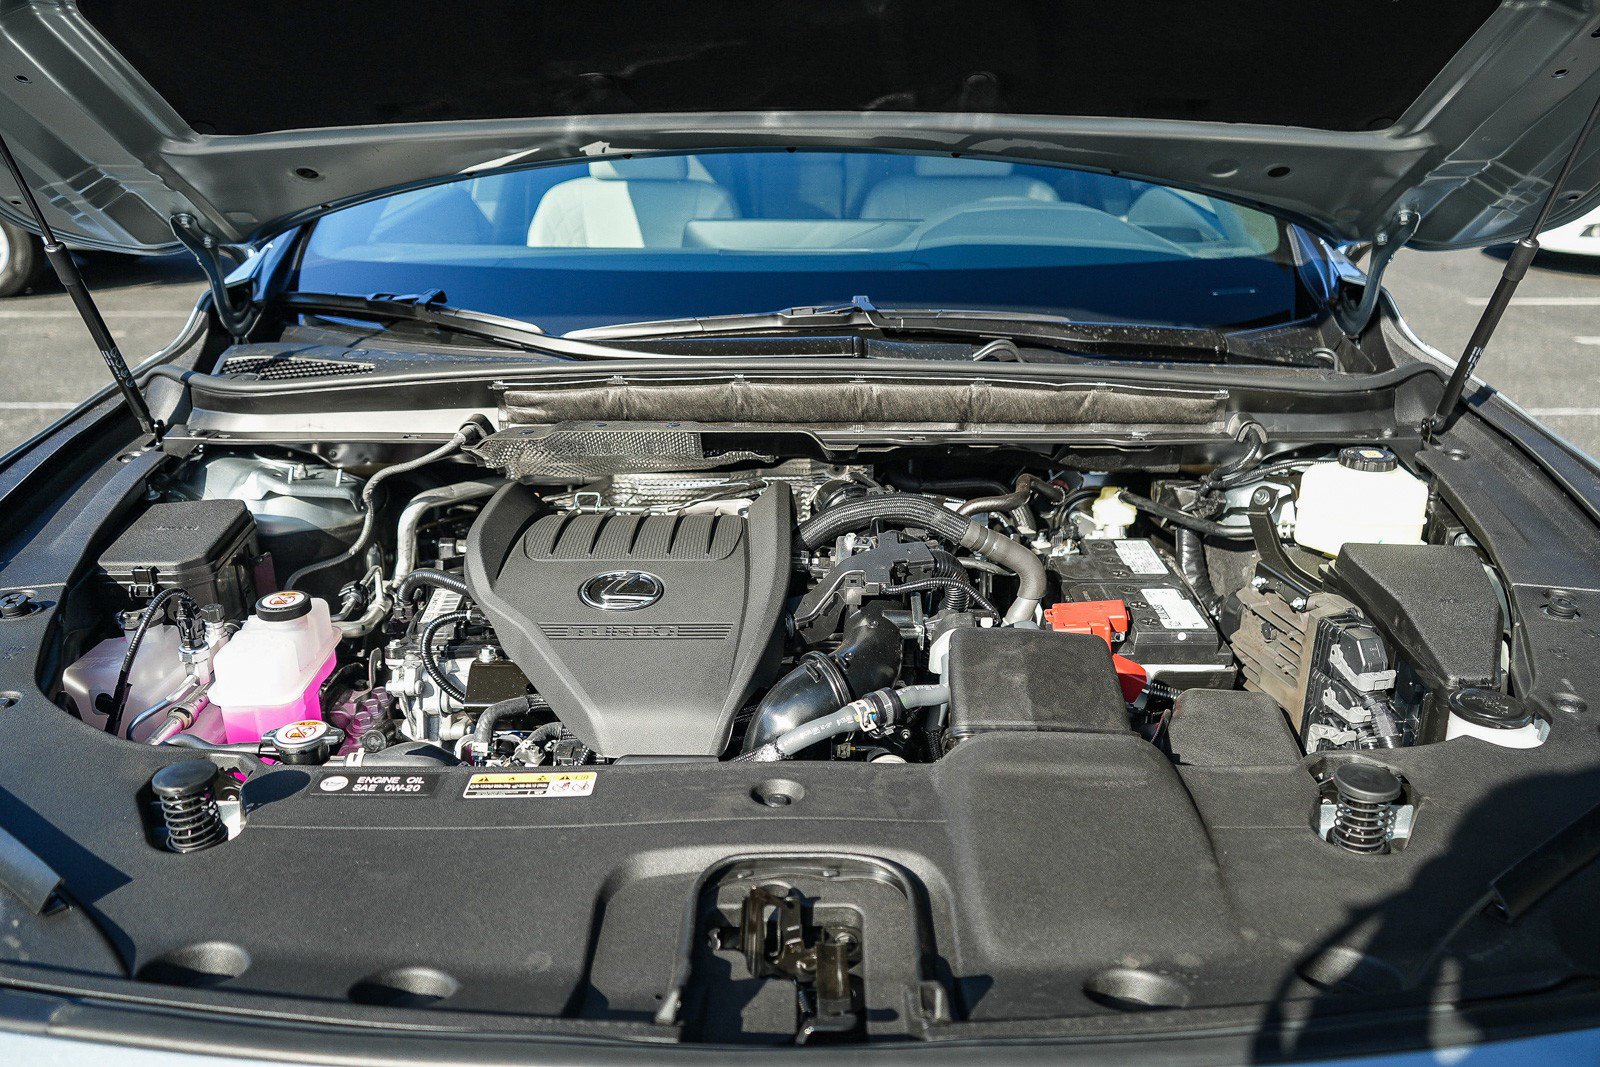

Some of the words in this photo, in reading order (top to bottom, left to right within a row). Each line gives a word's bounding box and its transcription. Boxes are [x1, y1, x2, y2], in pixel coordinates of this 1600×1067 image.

[571, 625, 675, 637] TURBO
[357, 776, 400, 784] ENGINE
[406, 776, 425, 784] OIL
[352, 784, 377, 792] SAE
[384, 784, 421, 792] 0W-20
